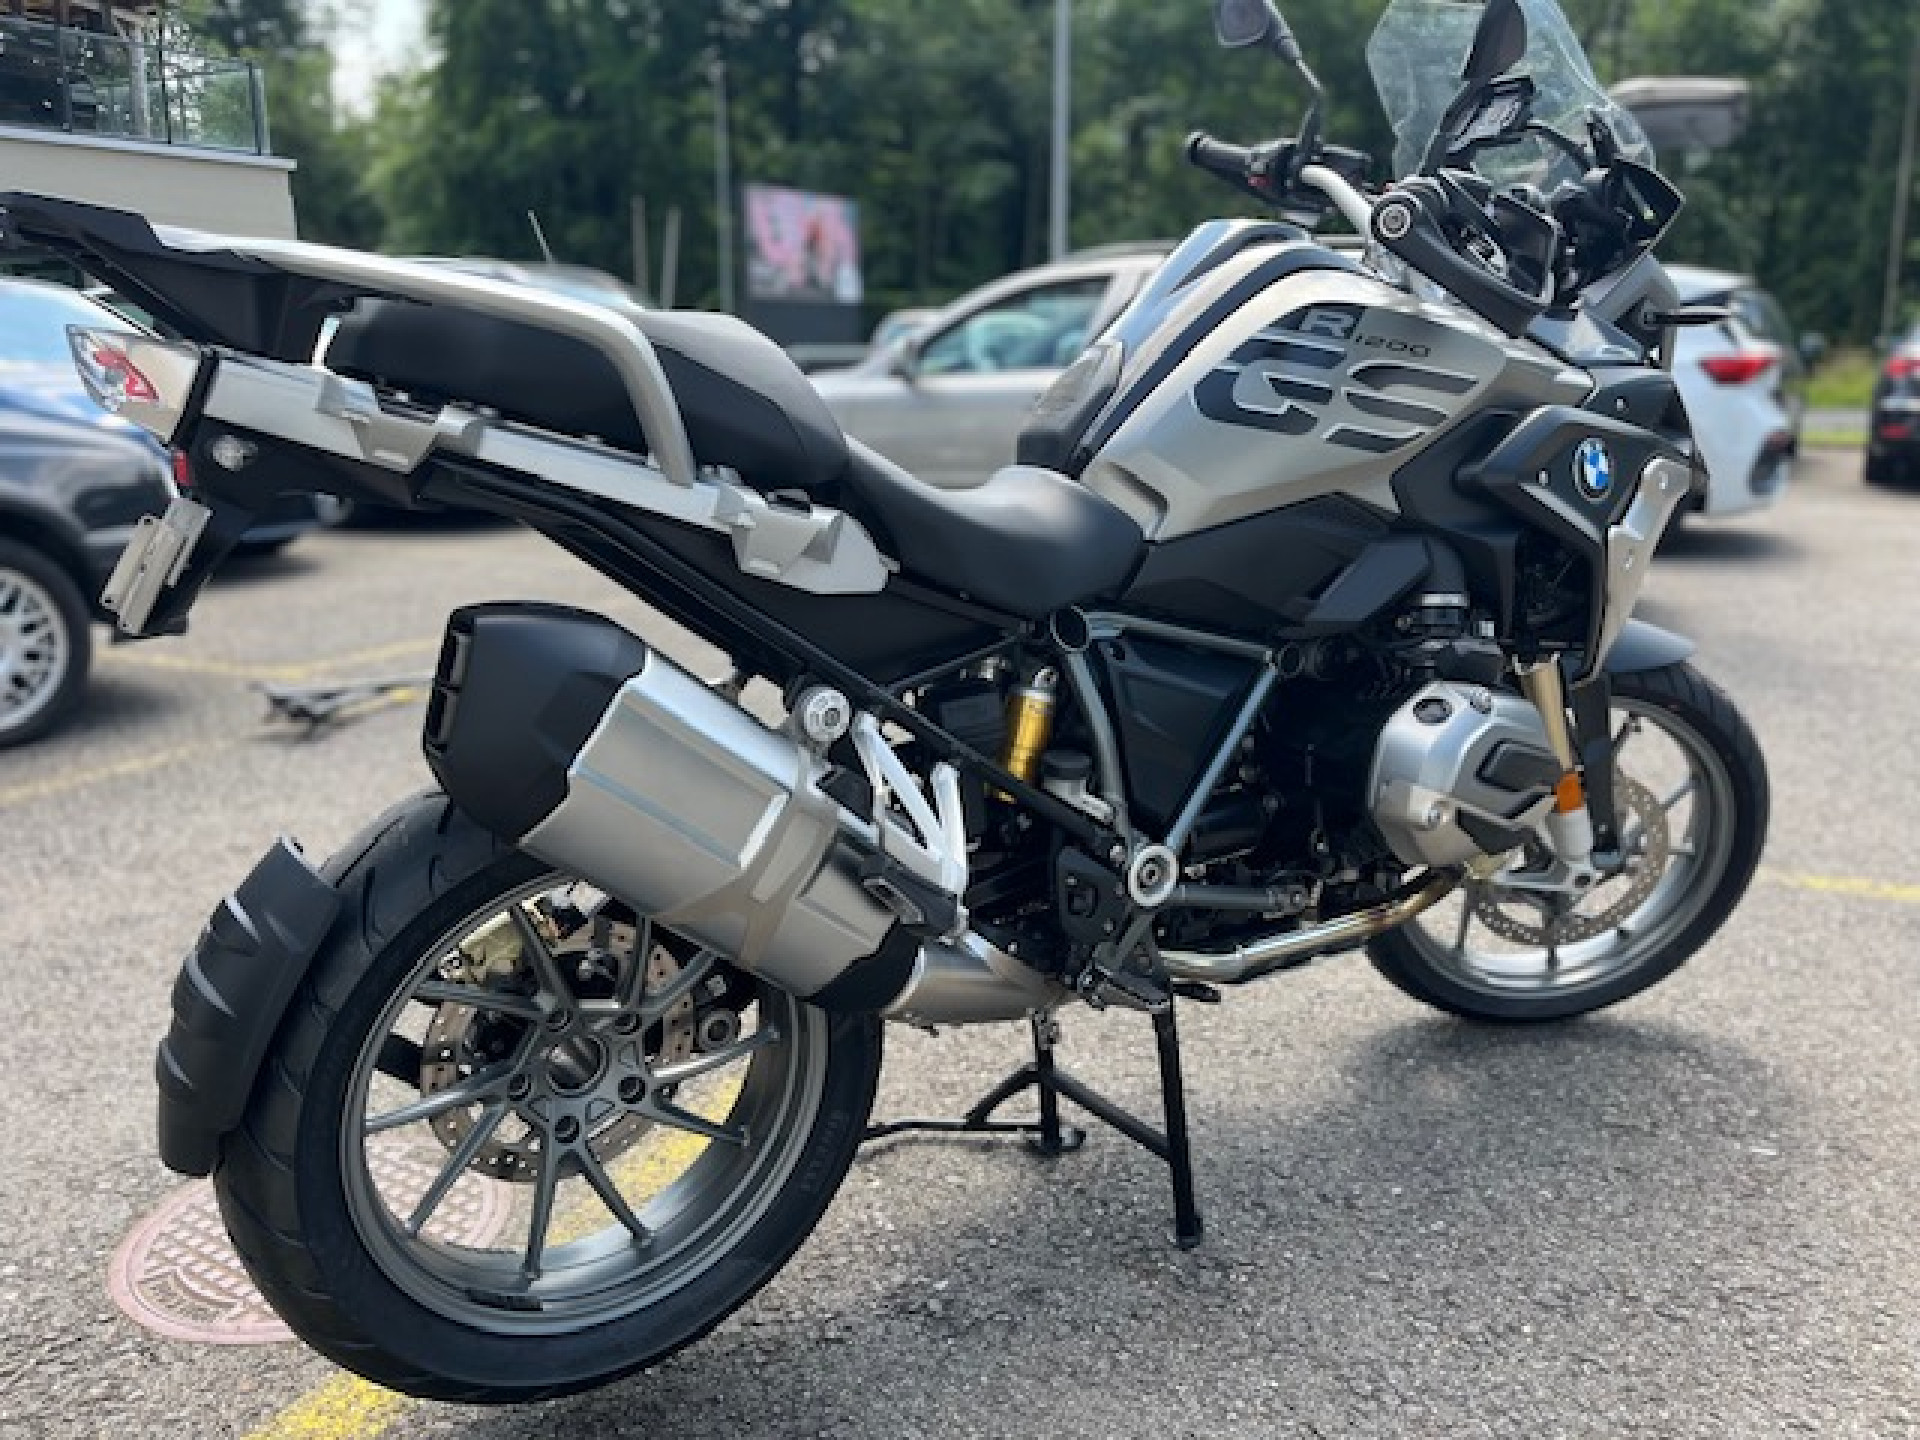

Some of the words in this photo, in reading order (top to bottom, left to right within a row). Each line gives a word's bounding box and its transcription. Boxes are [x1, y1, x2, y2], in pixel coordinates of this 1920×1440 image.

[1301, 309, 1354, 337] R
[1355, 333, 1431, 357] 1200
[1193, 334, 1480, 454] GS
